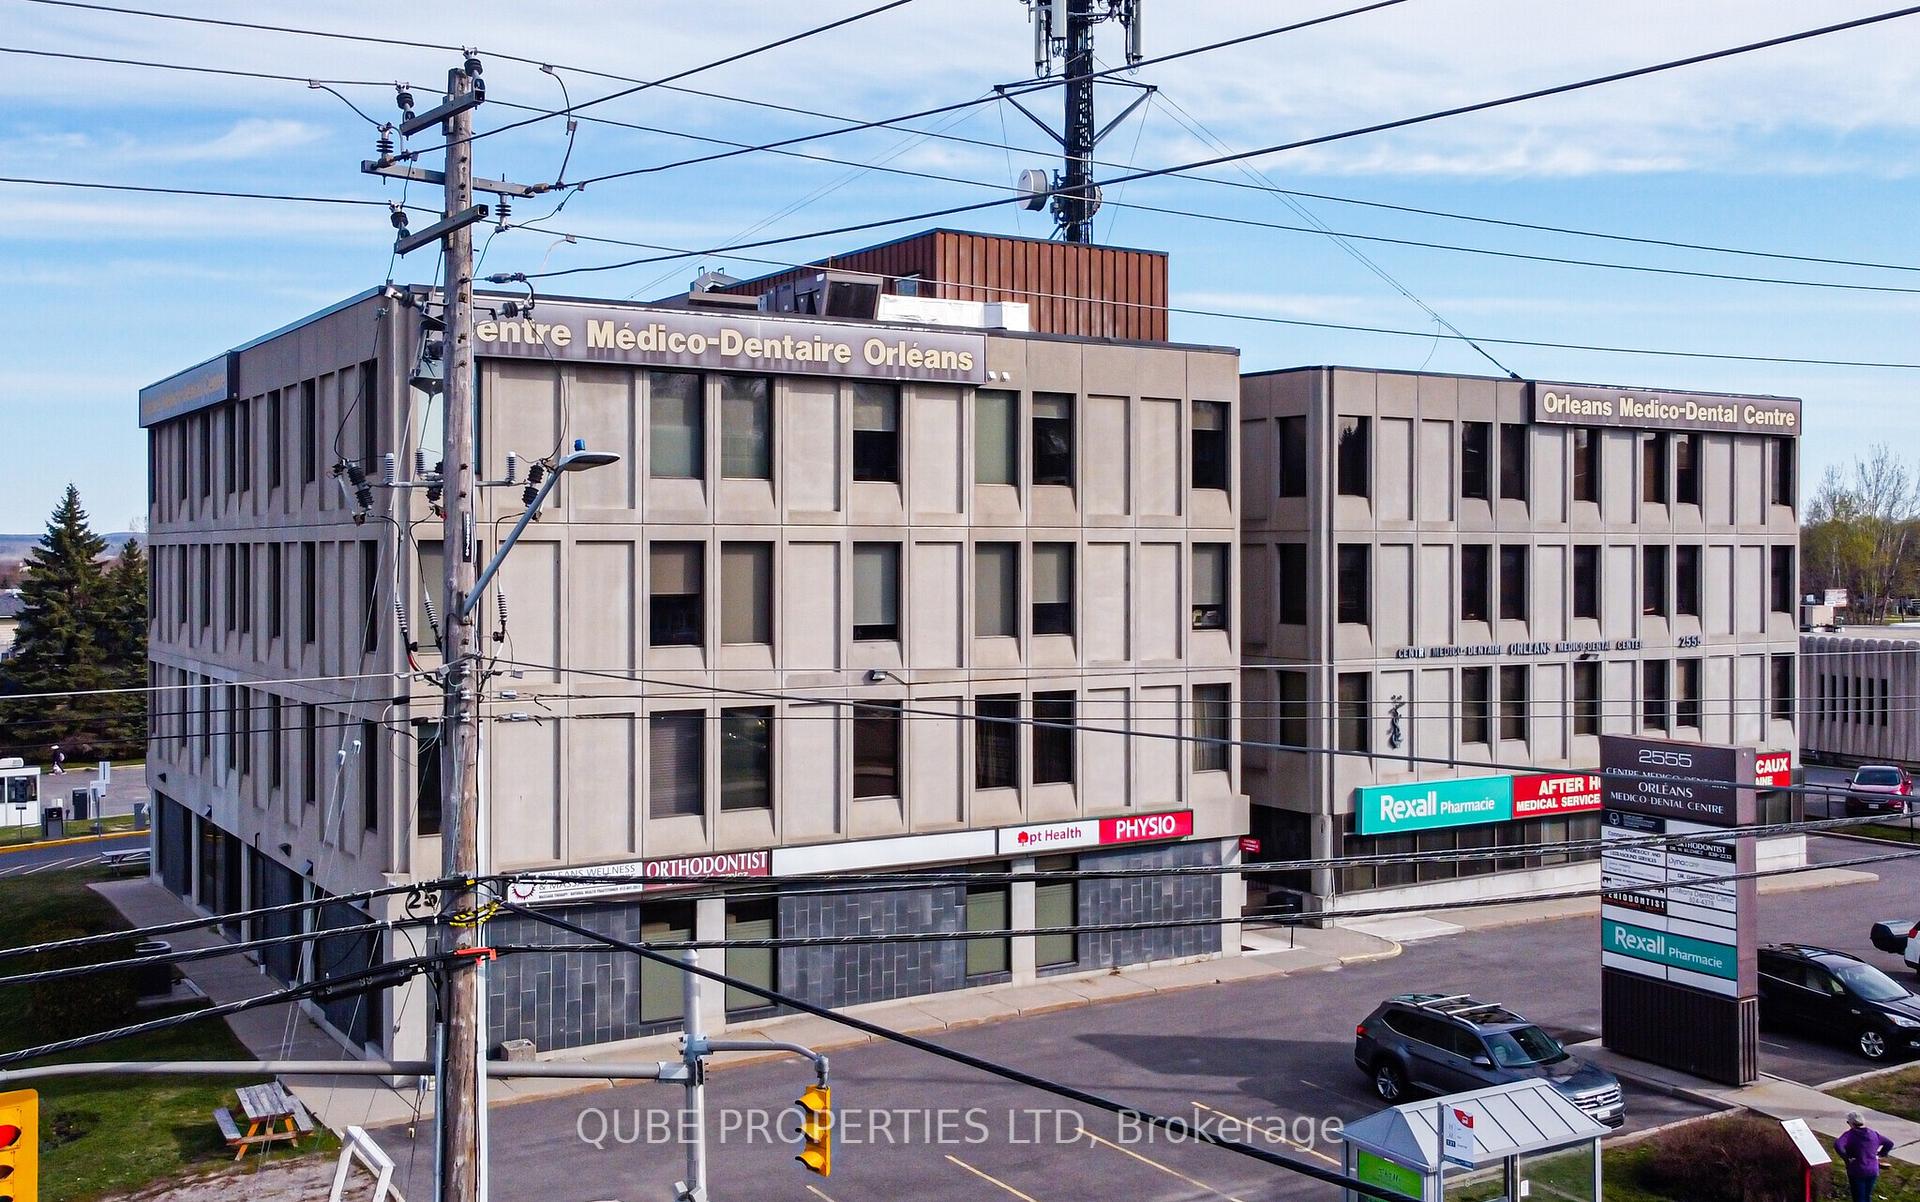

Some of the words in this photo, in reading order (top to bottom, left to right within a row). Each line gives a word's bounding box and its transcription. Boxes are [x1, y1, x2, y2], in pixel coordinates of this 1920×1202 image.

[474, 317, 572, 347] entre
[587, 319, 852, 364] Médico-Dentaire
[864, 338, 974, 371] Orléans
[1543, 391, 1613, 417] Orleans
[1620, 397, 1738, 424] Medico-Dental
[1744, 406, 1796, 427] Centre
[1638, 749, 1693, 768] 2555
[1538, 776, 1584, 796] AFTER
[1638, 781, 1694, 798] ORLÉANS
[1380, 790, 1437, 823] Rexall
[1441, 797, 1495, 815] Pharmacie
[1516, 797, 1559, 812] MEDICAL
[1610, 791, 1647, 804] MEDICO
[1650, 797, 1685, 809] DENTAL
[1687, 801, 1725, 815] CENTRE
[1045, 826, 1082, 841] Health
[1115, 815, 1176, 839] PHYSIO
[1677, 841, 1726, 854] THODONTIST
[646, 851, 768, 877] ORTHODONTIST
[1614, 926, 1665, 955] Rexall
[1668, 947, 1723, 969] Pharmacie
